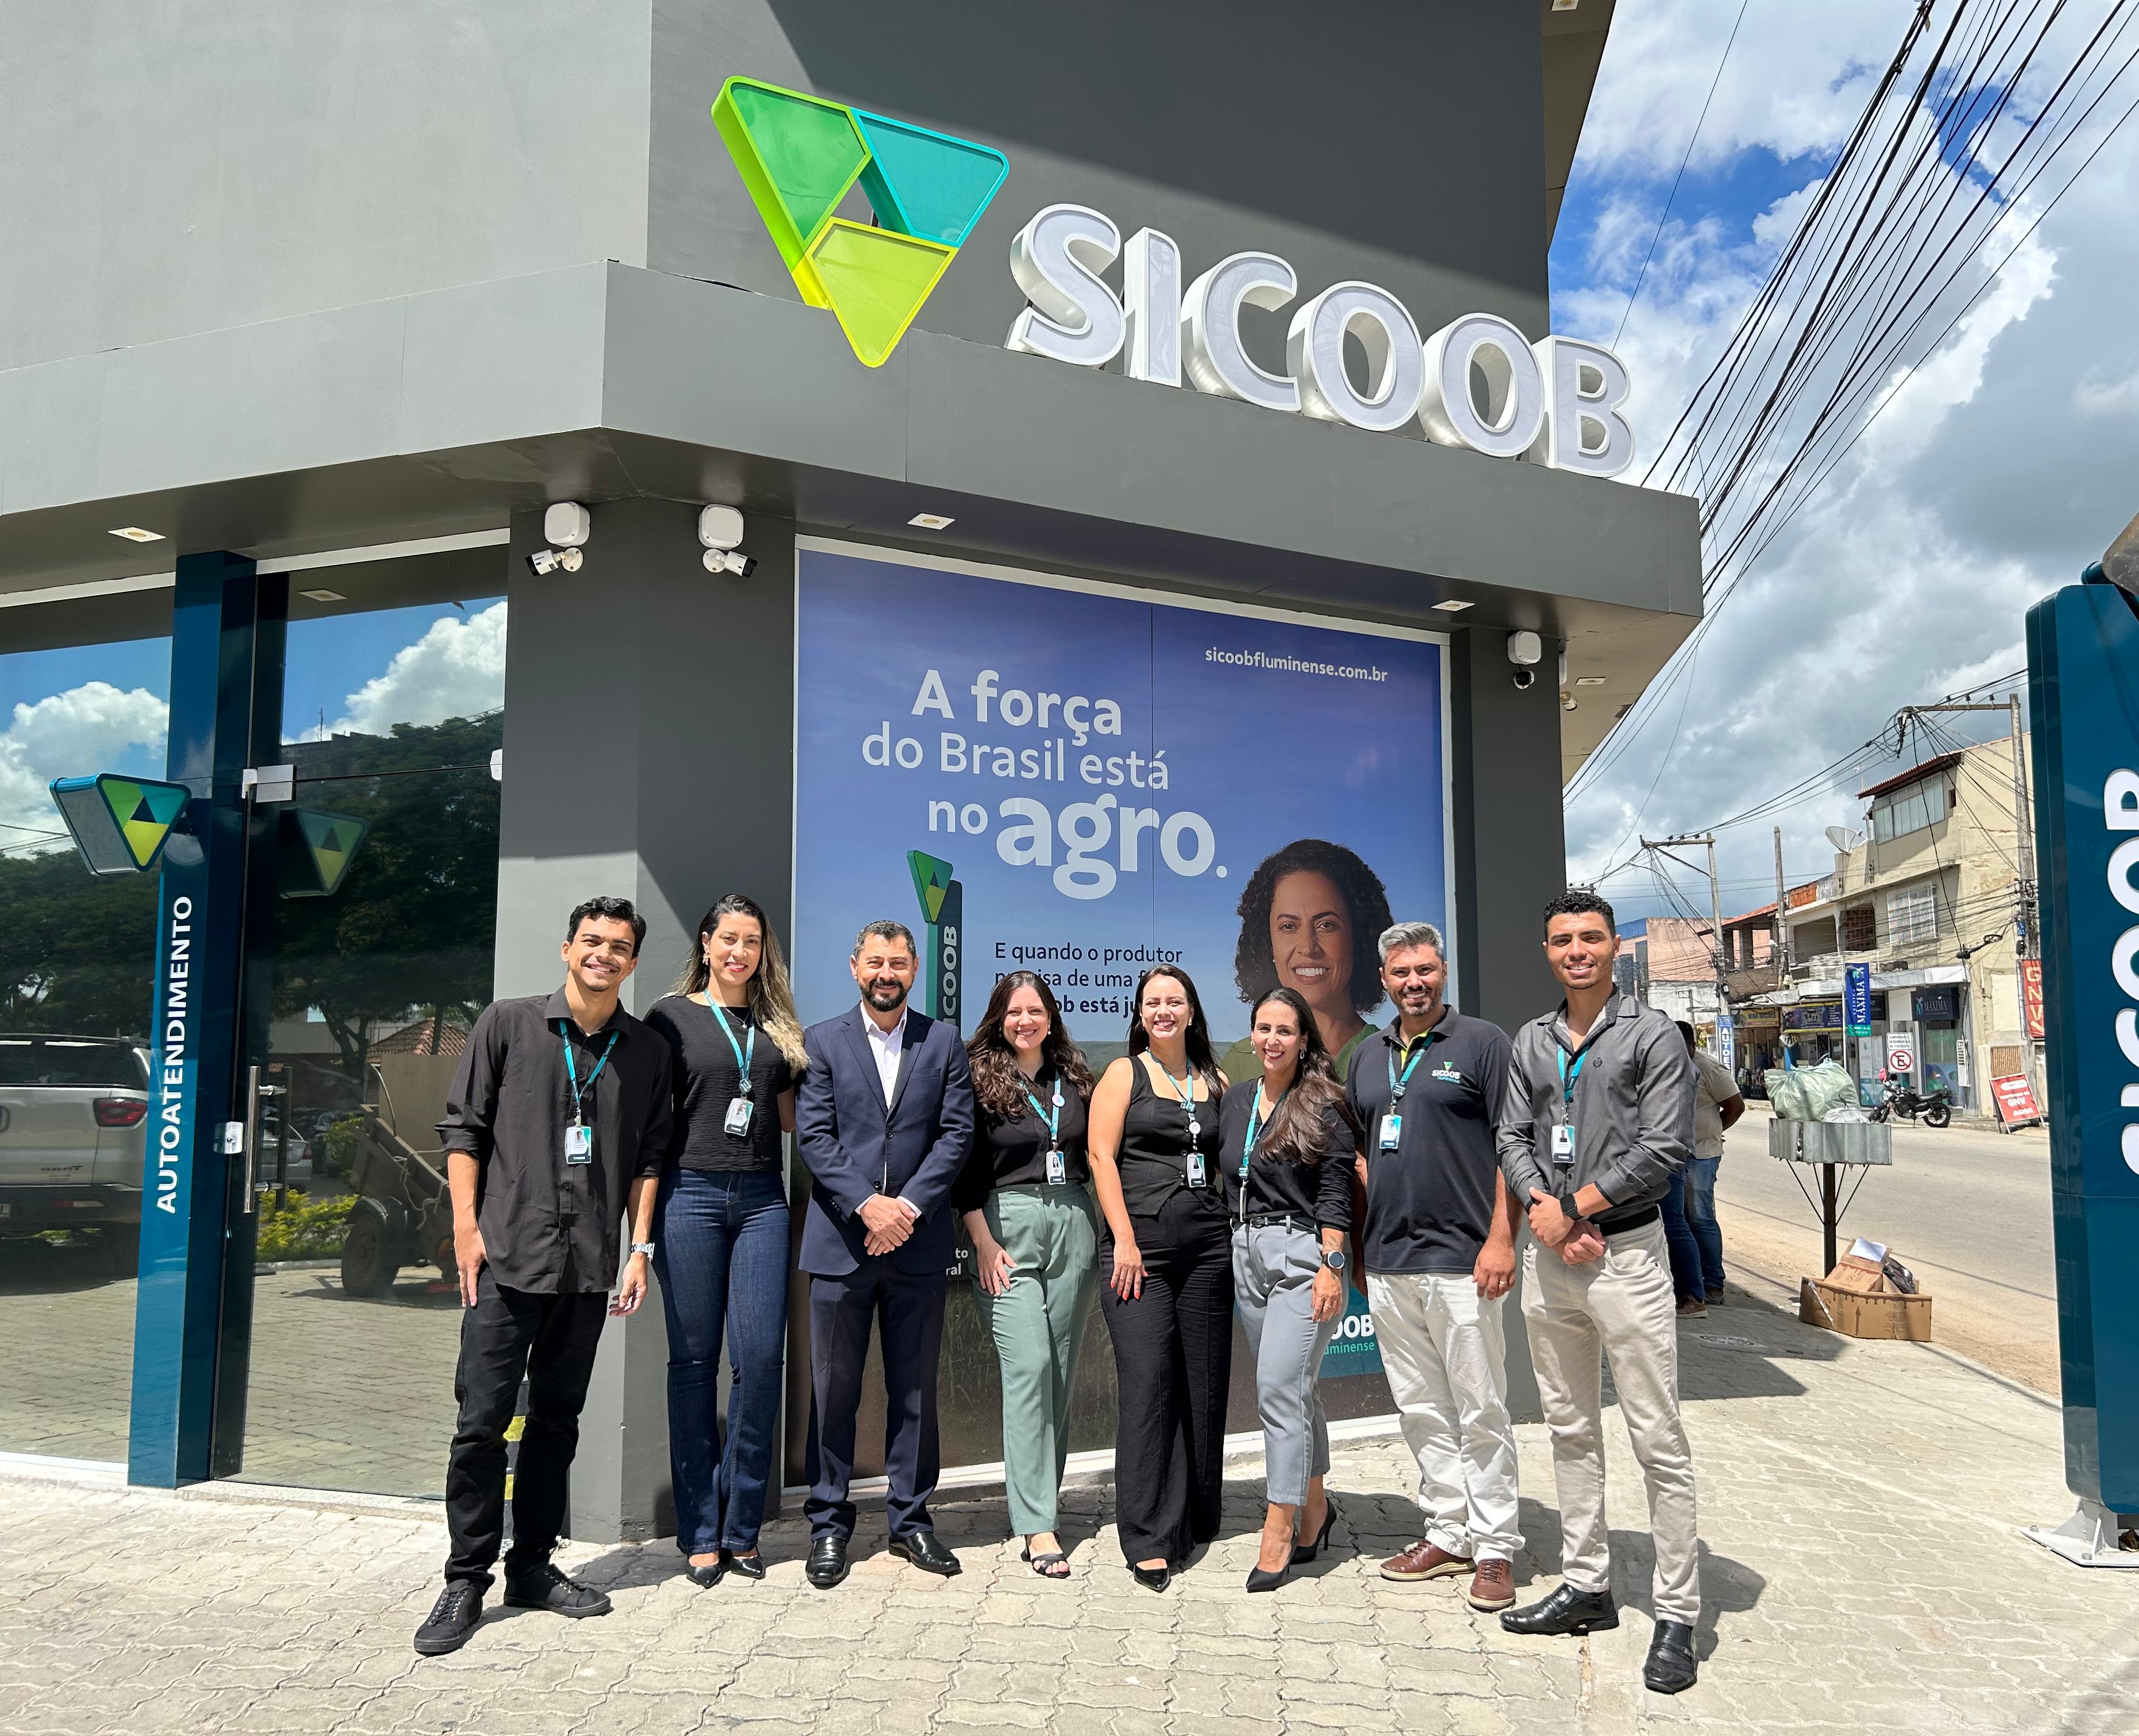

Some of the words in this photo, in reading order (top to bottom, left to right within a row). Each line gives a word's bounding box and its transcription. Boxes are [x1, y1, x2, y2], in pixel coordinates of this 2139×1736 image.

[1004, 203, 1635, 478] SICOOB
[1205, 646, 1388, 681] sicoobfluminense.com.br
[911, 669, 954, 720] A
[970, 669, 1123, 746] força
[862, 722, 921, 769] do
[939, 731, 1065, 782] Brasil
[1079, 750, 1169, 790] está
[929, 798, 989, 834] no
[996, 793, 1228, 900] agro.
[943, 925, 957, 1026] ICOOB
[995, 942, 1006, 958] E
[1012, 942, 1082, 964] quando
[1088, 948, 1098, 962] o
[1104, 944, 1183, 966] produtor
[1067, 968, 1089, 986] de
[1094, 975, 1132, 987] uma
[1080, 996, 1119, 1013] está
[156, 896, 192, 1214] AUTOATENDIMENTO
[1432, 1070, 1461, 1079] SICOOB
